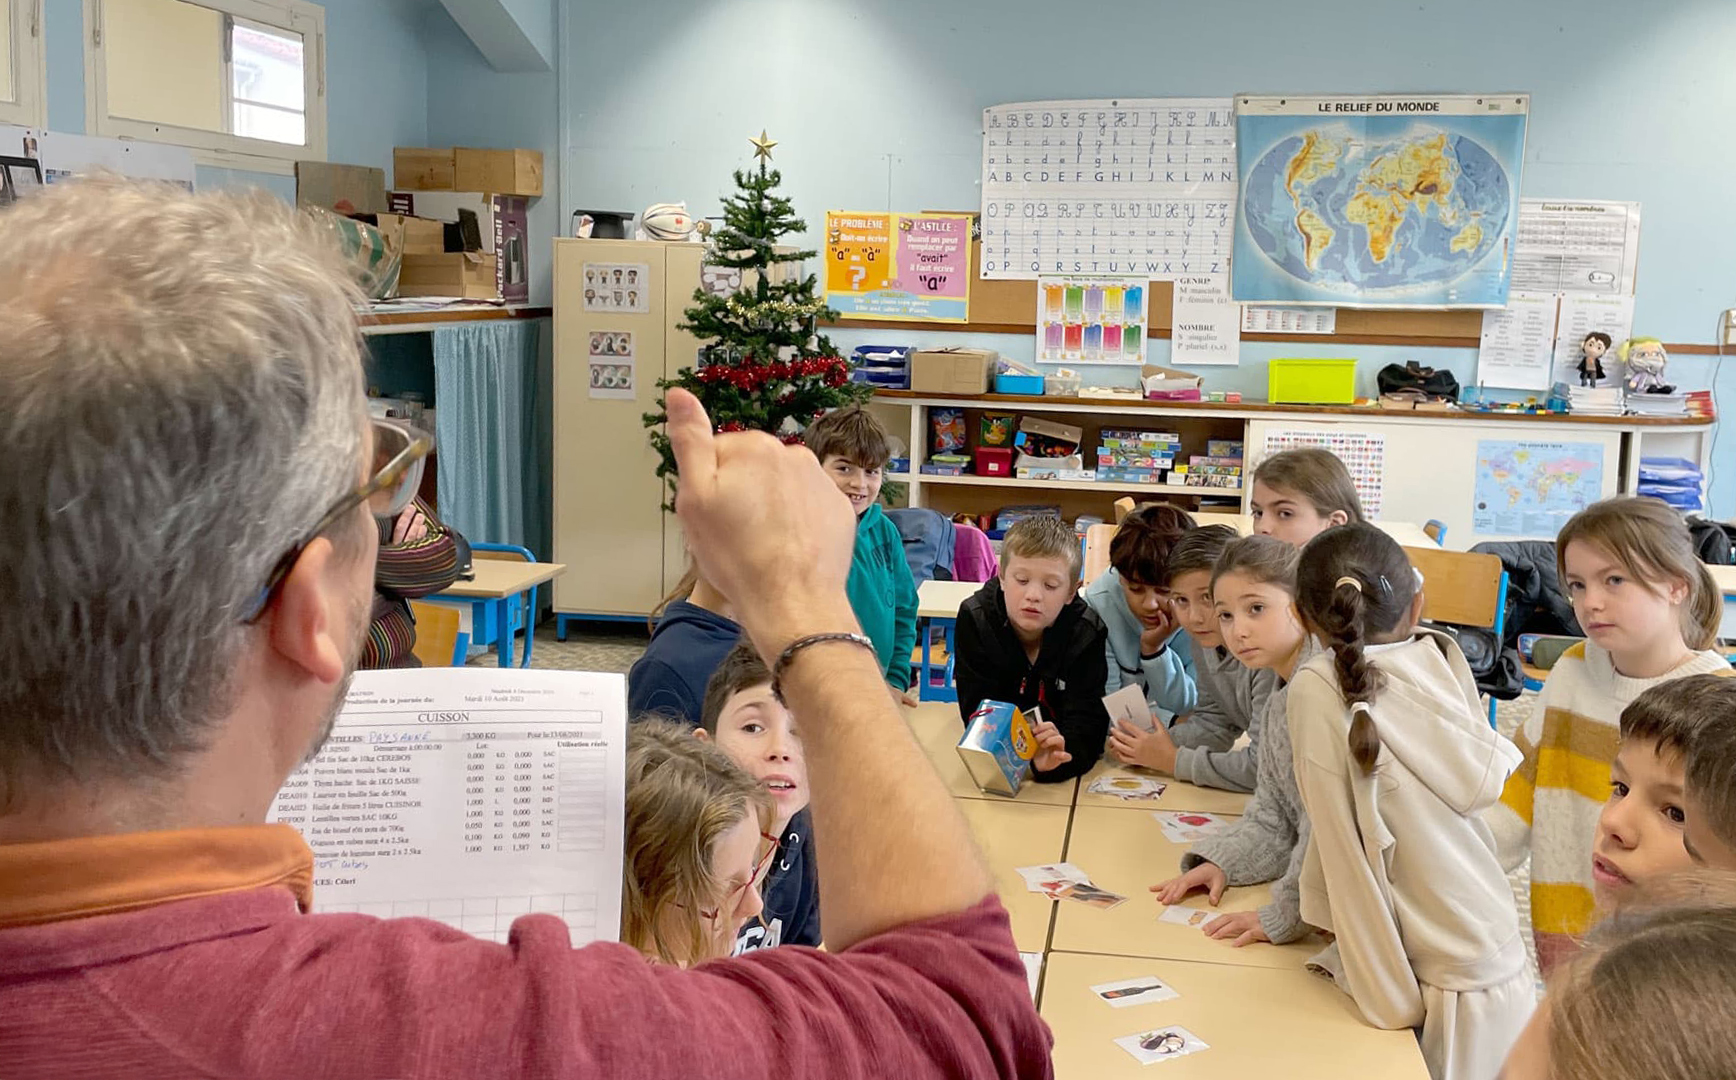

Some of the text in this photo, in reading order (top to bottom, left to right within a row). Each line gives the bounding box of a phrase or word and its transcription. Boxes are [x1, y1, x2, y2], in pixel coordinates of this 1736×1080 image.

[1318, 102, 1440, 112] LE RELIEF DU MONDE
[988, 171, 1231, 182] A B C D E F G H I J K L M N
[829, 218, 839, 228] LE
[986, 261, 1220, 273] O P Q R S T U V W X Y Z
[1179, 324, 1216, 332] NOMBRE
[418, 712, 470, 723] CUISSON
